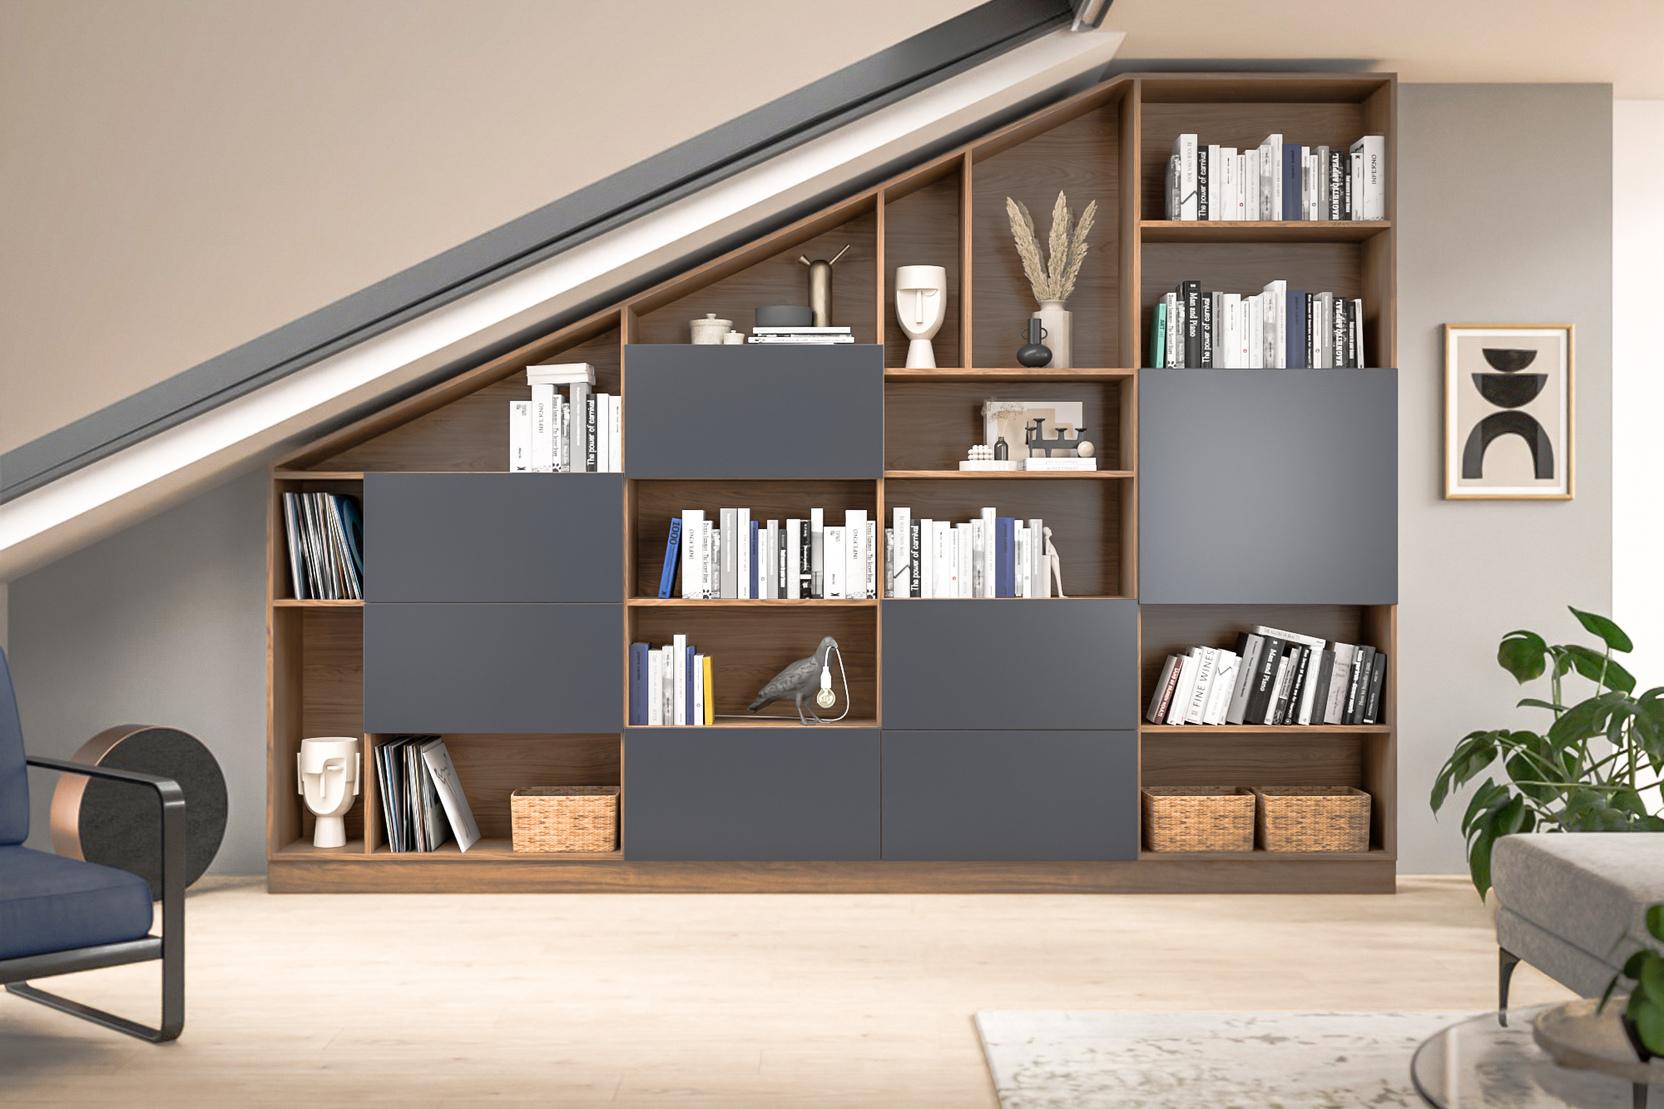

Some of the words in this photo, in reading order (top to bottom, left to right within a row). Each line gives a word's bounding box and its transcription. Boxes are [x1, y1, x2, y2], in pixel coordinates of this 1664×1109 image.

[1198, 151, 1207, 175] carnival
[1198, 176, 1207, 184] of
[1200, 185, 1208, 204] power
[1198, 205, 1207, 217] The
[1189, 292, 1198, 306] Man
[1189, 307, 1198, 319] and
[1202, 298, 1211, 322] carnival
[1189, 320, 1198, 337] Piano
[1202, 322, 1211, 330] of
[1204, 332, 1212, 350] power
[1202, 352, 1211, 363] The
[587, 424, 595, 433] of
[588, 434, 597, 453] power
[587, 454, 595, 466] The
[669, 521, 680, 545] 1000
[911, 525, 919, 549] carnival
[911, 550, 919, 558] of
[911, 578, 919, 591] The
[1268, 648, 1277, 662] Man
[1192, 685, 1205, 707] FINE
[1200, 650, 1215, 682] WINES
[1260, 674, 1270, 692] Piano
